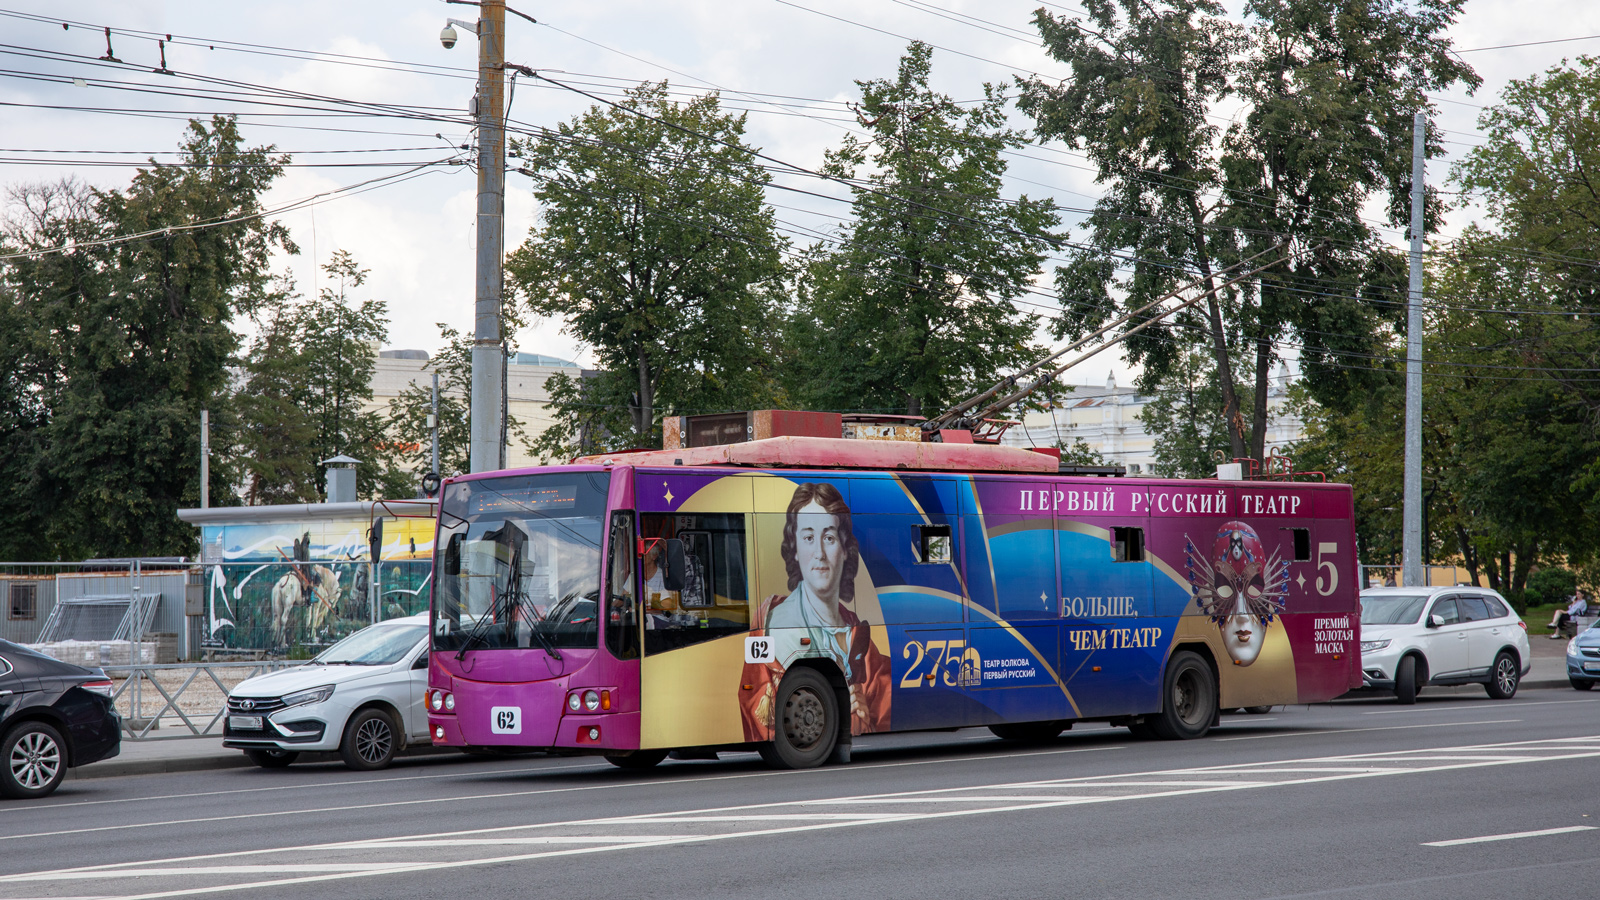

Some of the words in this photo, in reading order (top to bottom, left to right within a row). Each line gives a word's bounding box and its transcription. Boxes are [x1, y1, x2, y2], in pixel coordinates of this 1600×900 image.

[1019, 487, 1115, 511] ПЕРВЫЙ
[1130, 490, 1228, 514] РУССКИЙ
[1241, 495, 1301, 515] ТЕАТР
[1315, 542, 1339, 597] 5
[1060, 596, 1139, 619] БОЛЬШЕ,
[1314, 616, 1350, 630] ПРЕМИЙ
[1069, 629, 1108, 651] ЧЕМ
[1110, 627, 1162, 649] ТЕАТР
[1314, 630, 1354, 642] ЗОЛОТАЯ
[750, 640, 770, 659] 62
[1314, 642, 1345, 655] МАСКА
[899, 639, 967, 688] 275
[983, 659, 1000, 669] ТЕАТР
[1001, 658, 1030, 668] ВОЛКОВА
[983, 670, 1008, 680] ПЕРВЫЙ
[1008, 668, 1036, 679] РУССКИЙ
[497, 711, 516, 730] 62
